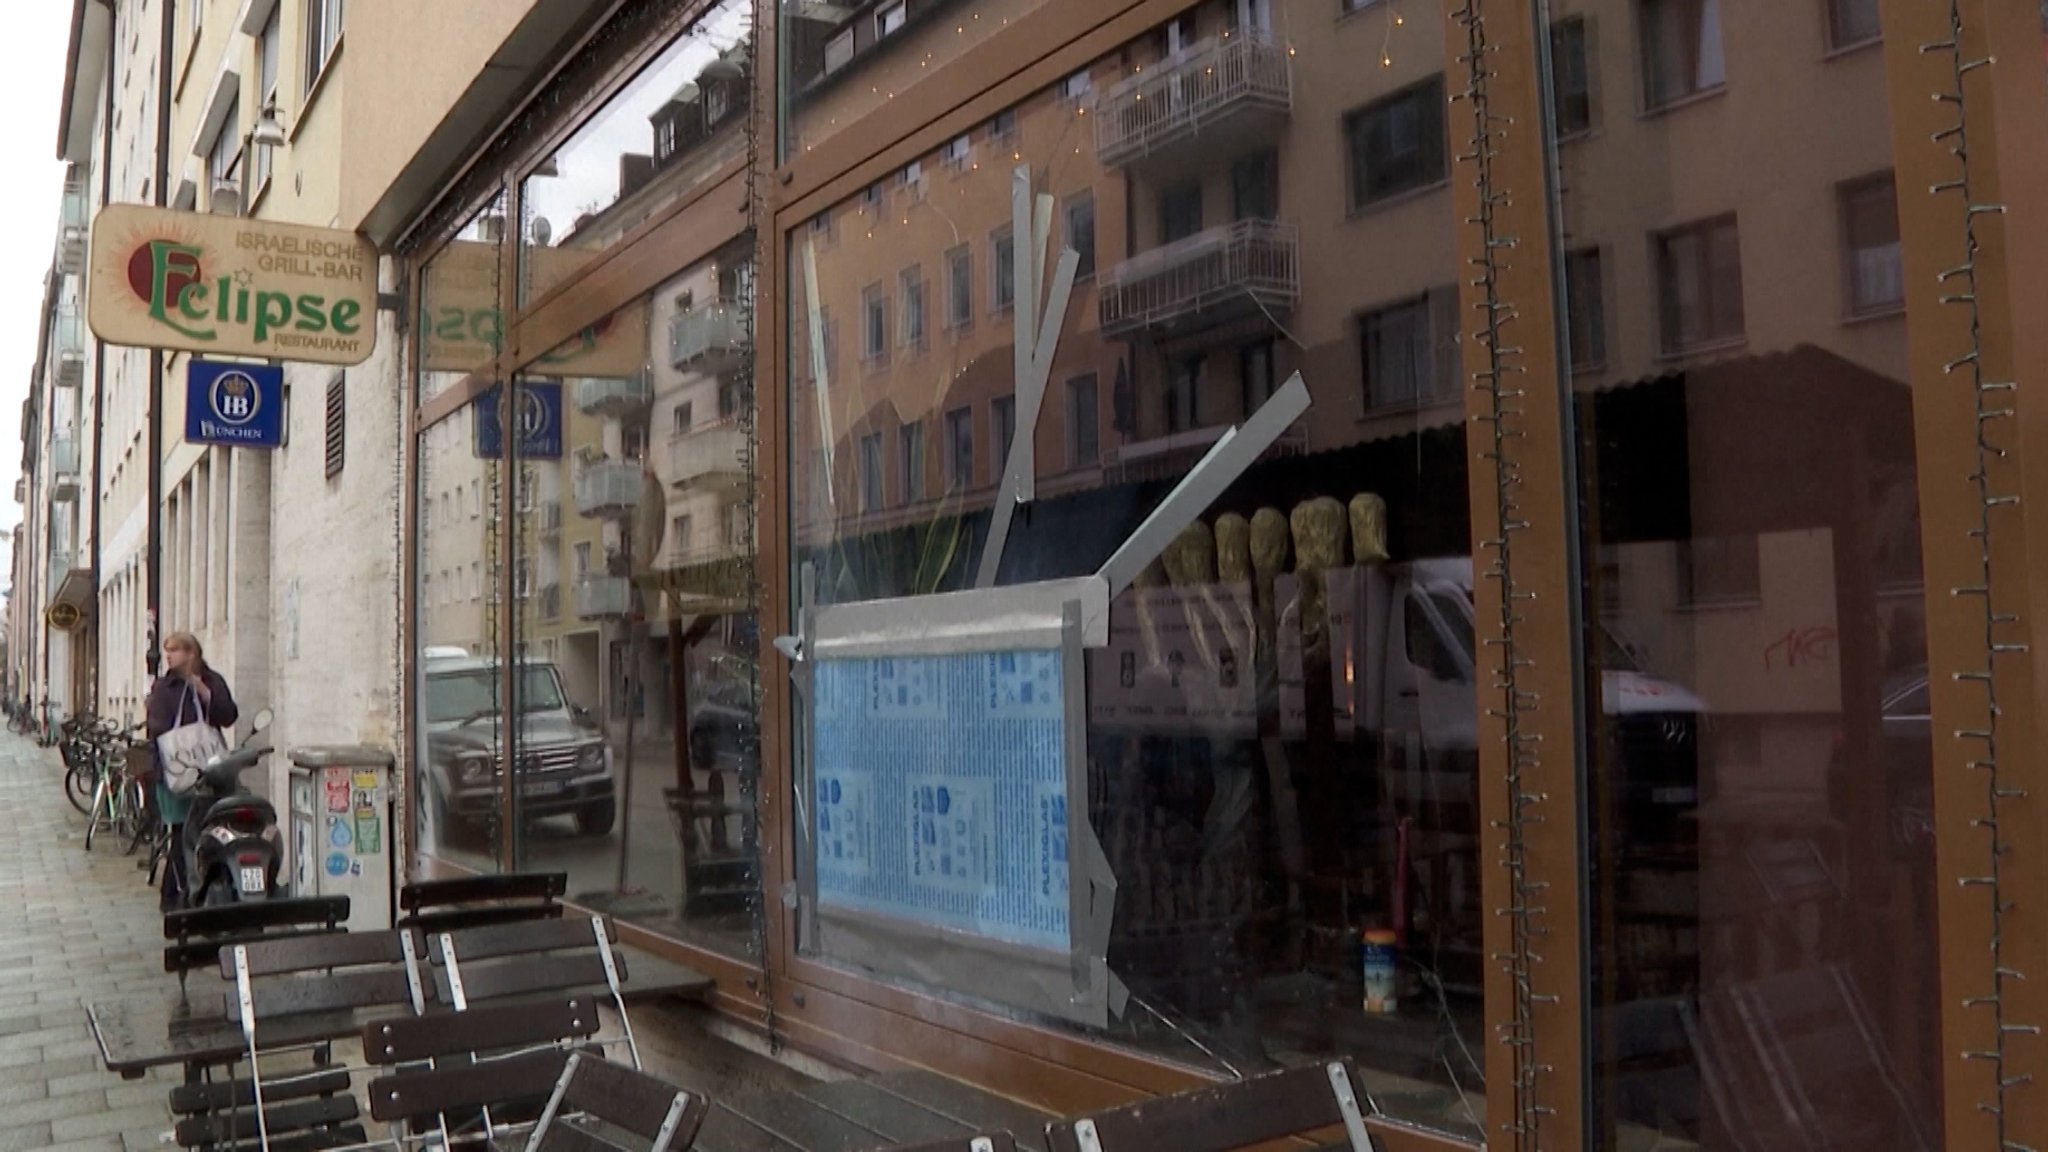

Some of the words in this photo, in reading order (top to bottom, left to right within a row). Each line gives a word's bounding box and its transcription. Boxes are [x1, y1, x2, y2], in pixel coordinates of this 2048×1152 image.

[235, 231, 365, 262] ISRAELISCHE
[148, 240, 361, 344] Eclipse
[274, 333, 360, 352] RESTAURANT
[223, 395, 248, 416] HB
